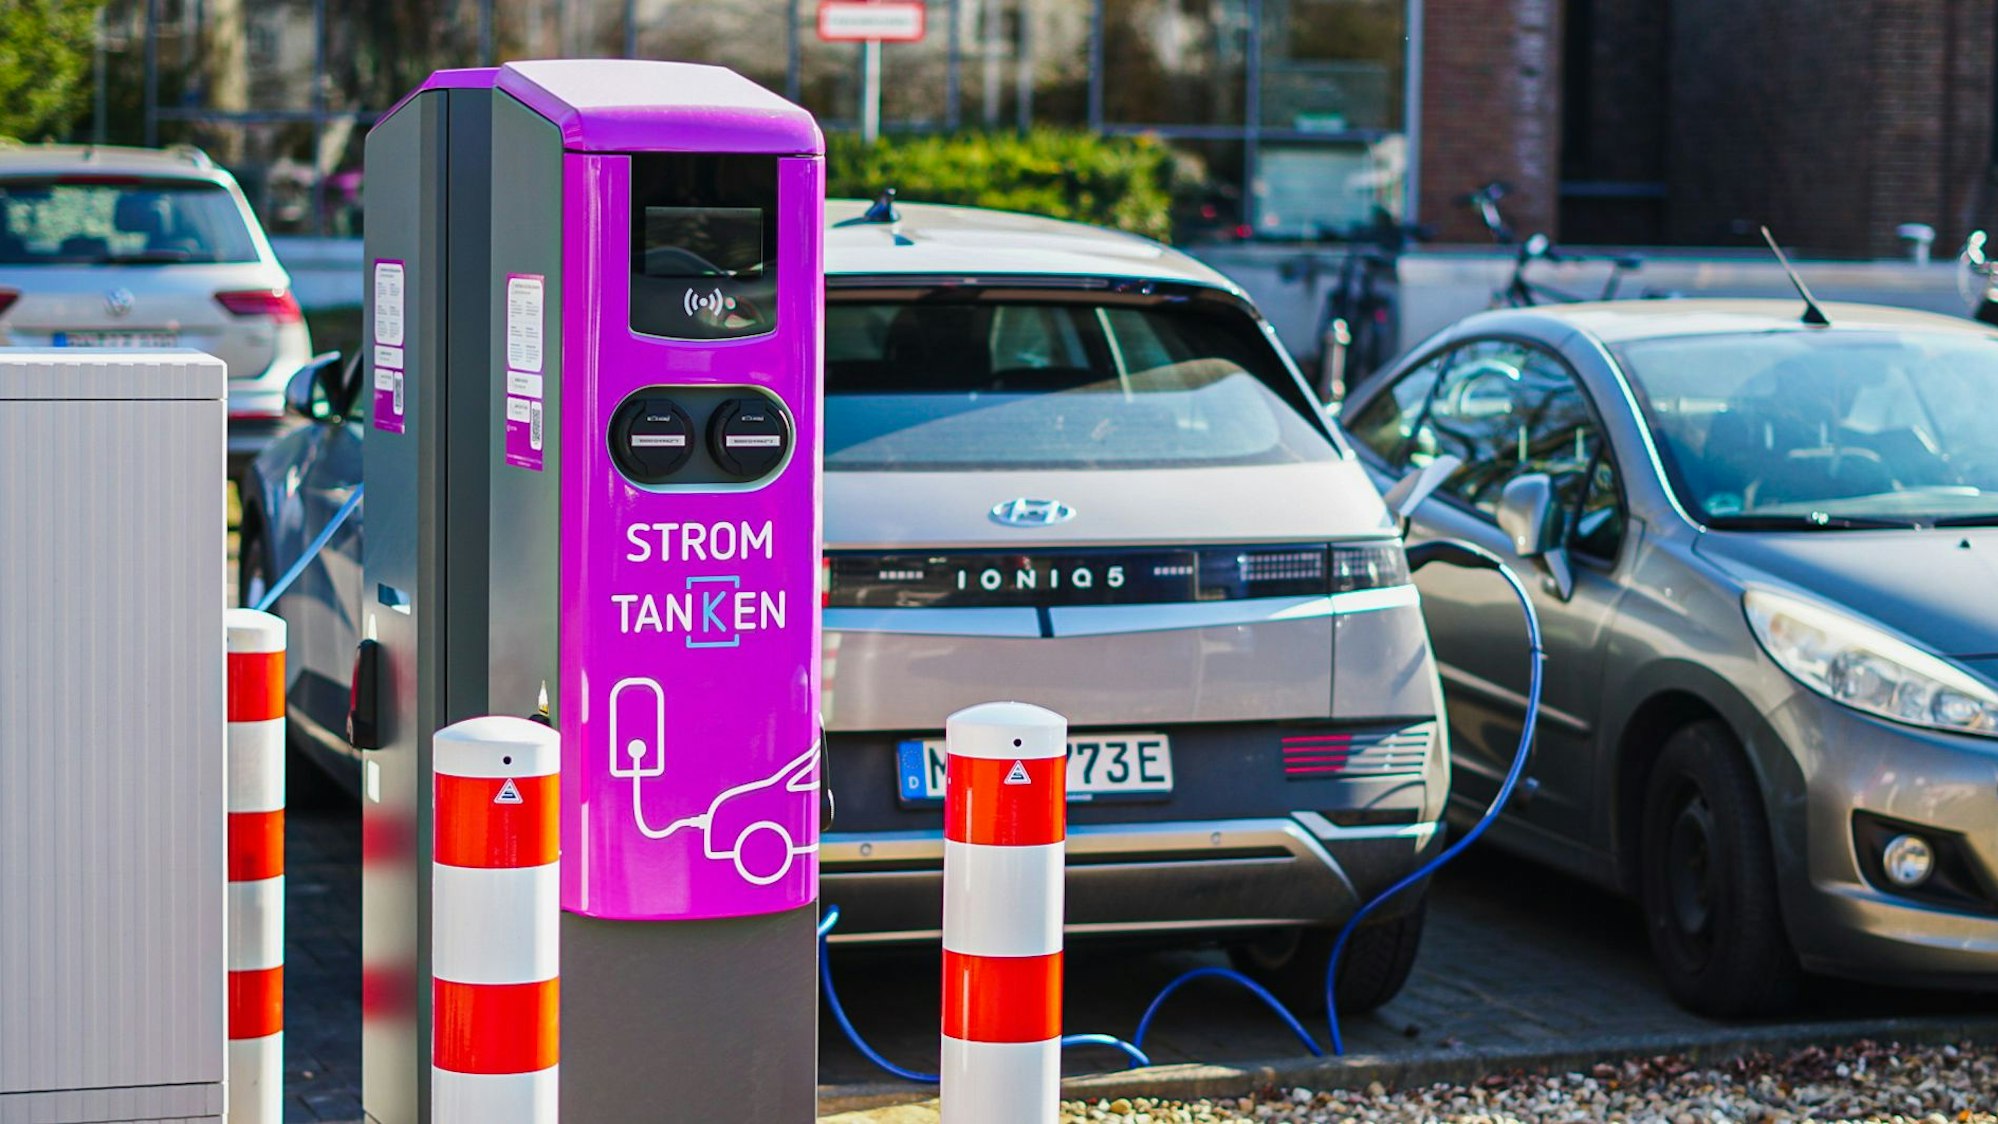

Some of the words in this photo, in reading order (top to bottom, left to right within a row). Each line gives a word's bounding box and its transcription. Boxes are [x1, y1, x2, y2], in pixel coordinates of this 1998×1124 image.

[626, 520, 773, 562] STROM
[610, 589, 787, 634] TANKEN
[908, 776, 920, 790] D
